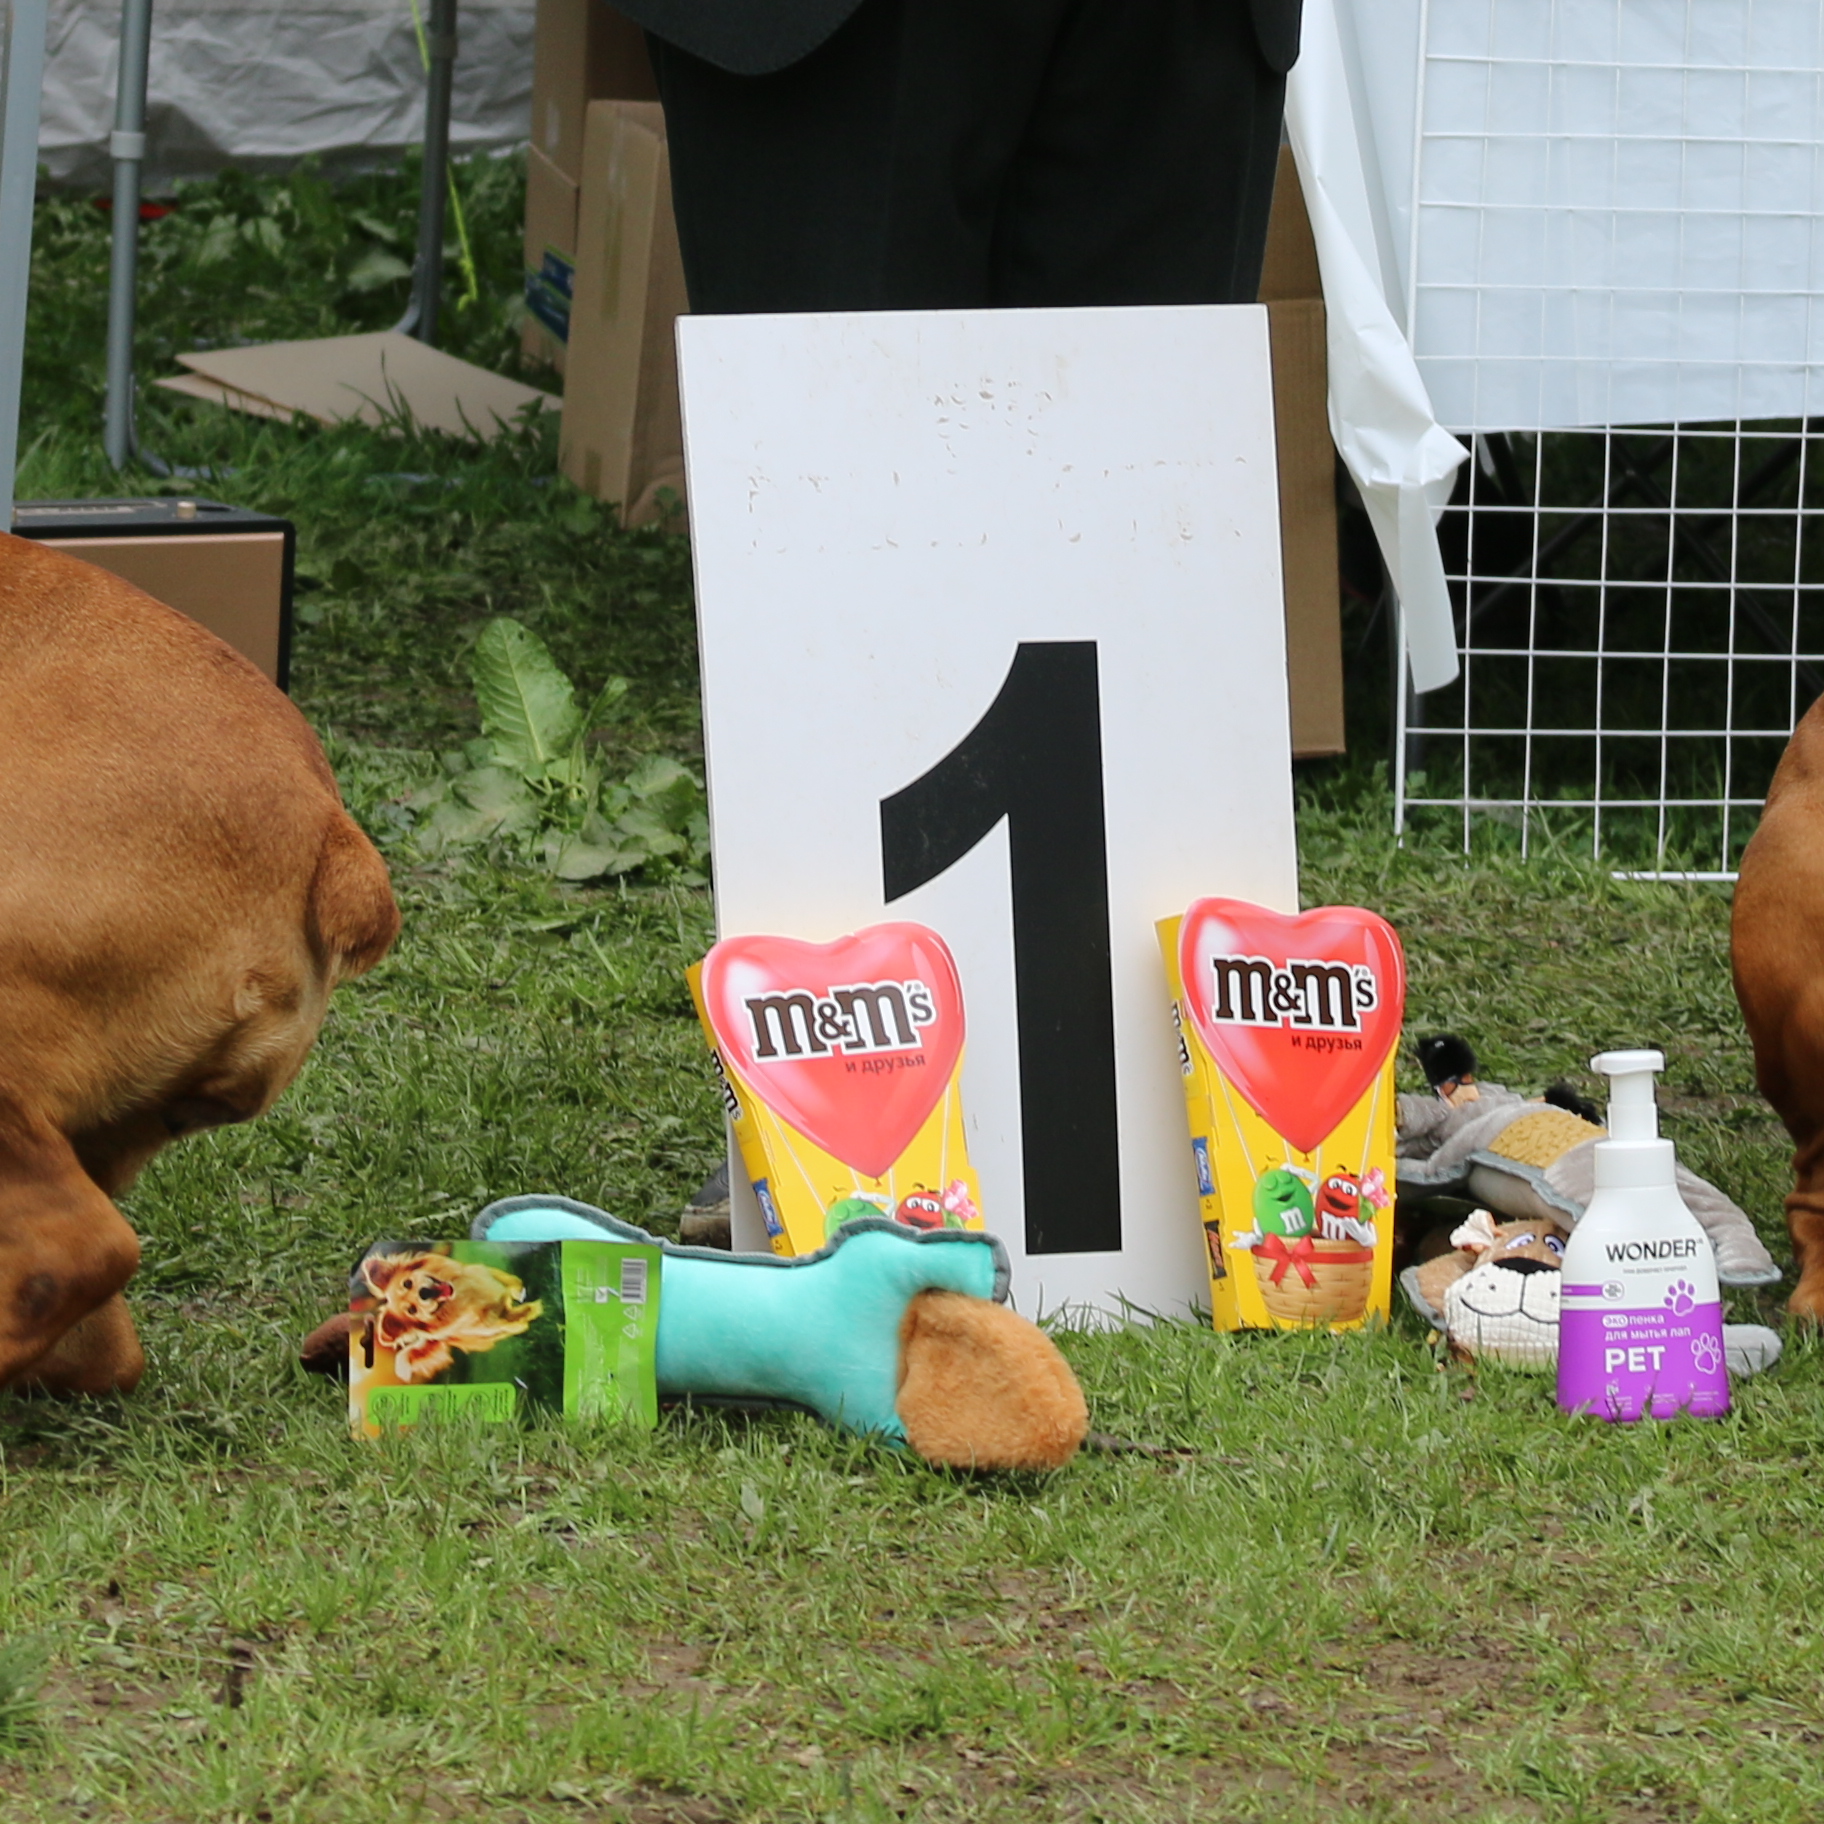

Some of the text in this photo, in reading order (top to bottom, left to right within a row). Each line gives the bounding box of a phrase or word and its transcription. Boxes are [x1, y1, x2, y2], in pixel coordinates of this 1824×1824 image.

[879, 640, 1123, 1255] 1
[1291, 1035, 1363, 1054] и друзья
[845, 1054, 926, 1075] и друзья
[1605, 1238, 1697, 1263] WONDER
[1605, 1314, 1665, 1327] ЭКО пенка
[1605, 1327, 1691, 1342] для мытья лап
[1605, 1345, 1666, 1374] PET
